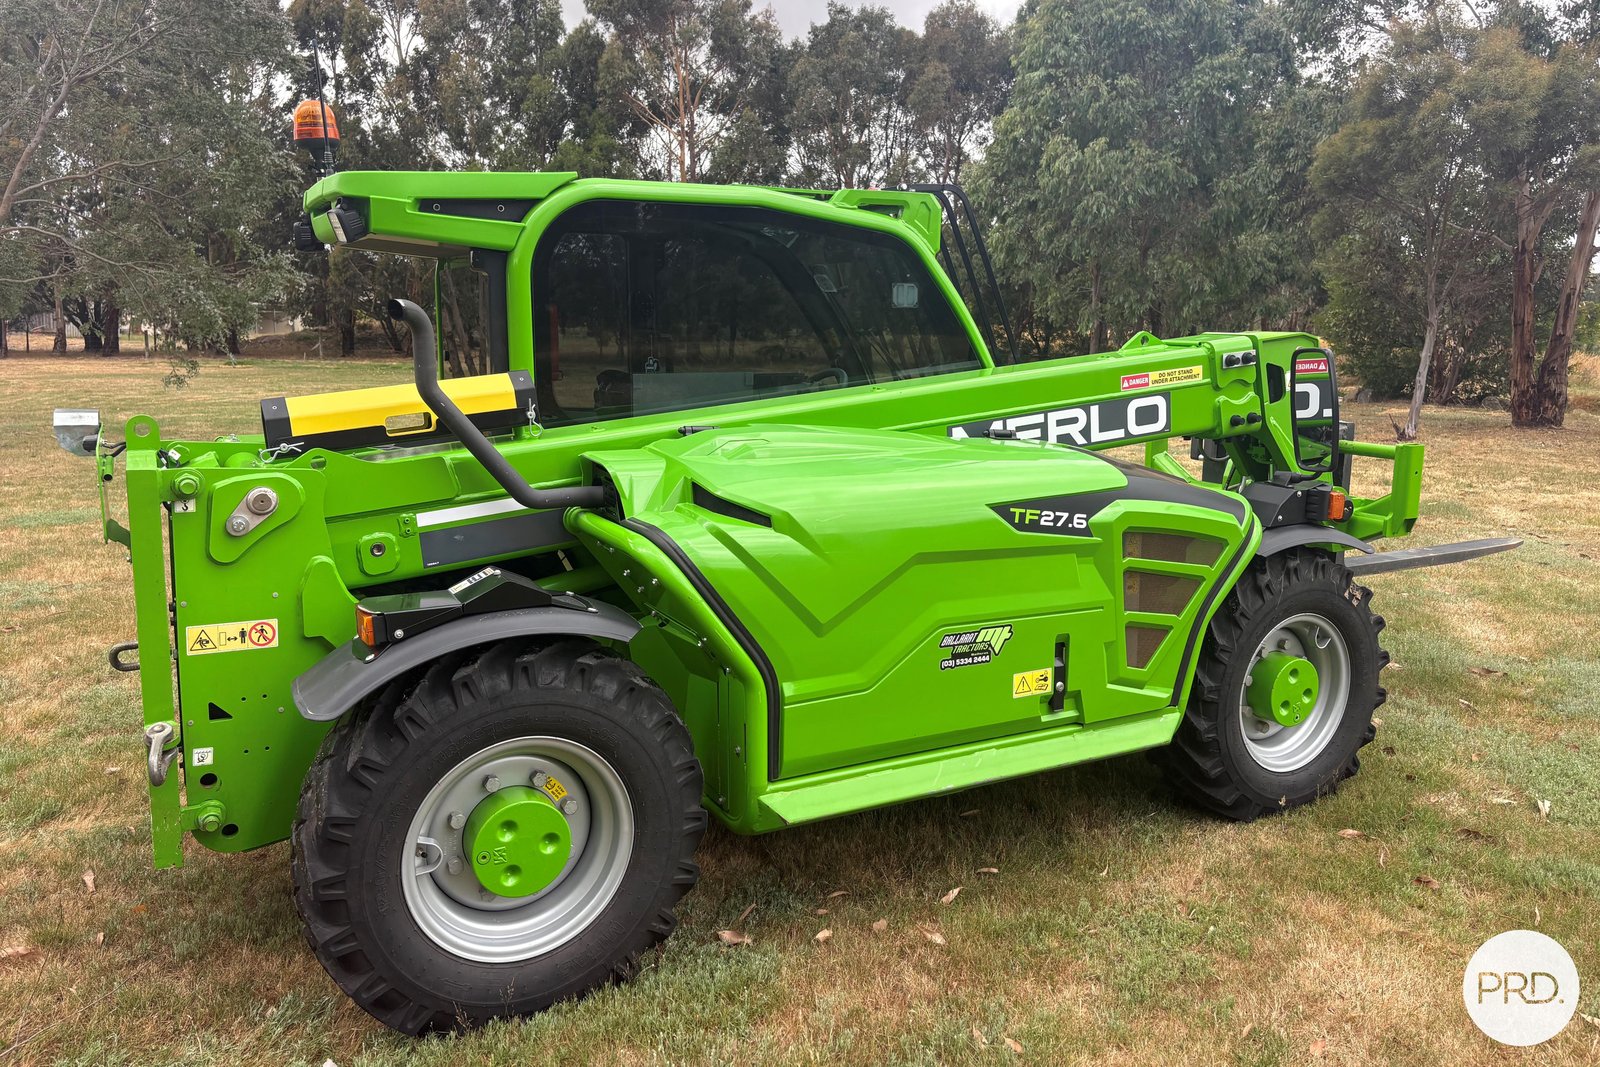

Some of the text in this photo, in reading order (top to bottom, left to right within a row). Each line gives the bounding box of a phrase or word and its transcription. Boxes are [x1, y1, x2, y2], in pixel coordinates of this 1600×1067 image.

[1129, 377, 1149, 386] DANGER
[1169, 373, 1200, 382] ATTACHMENT
[1010, 508, 1087, 529] TF27.6
[952, 642, 990, 654] TRACTORS
[941, 655, 990, 669] (03) 5334 2444
